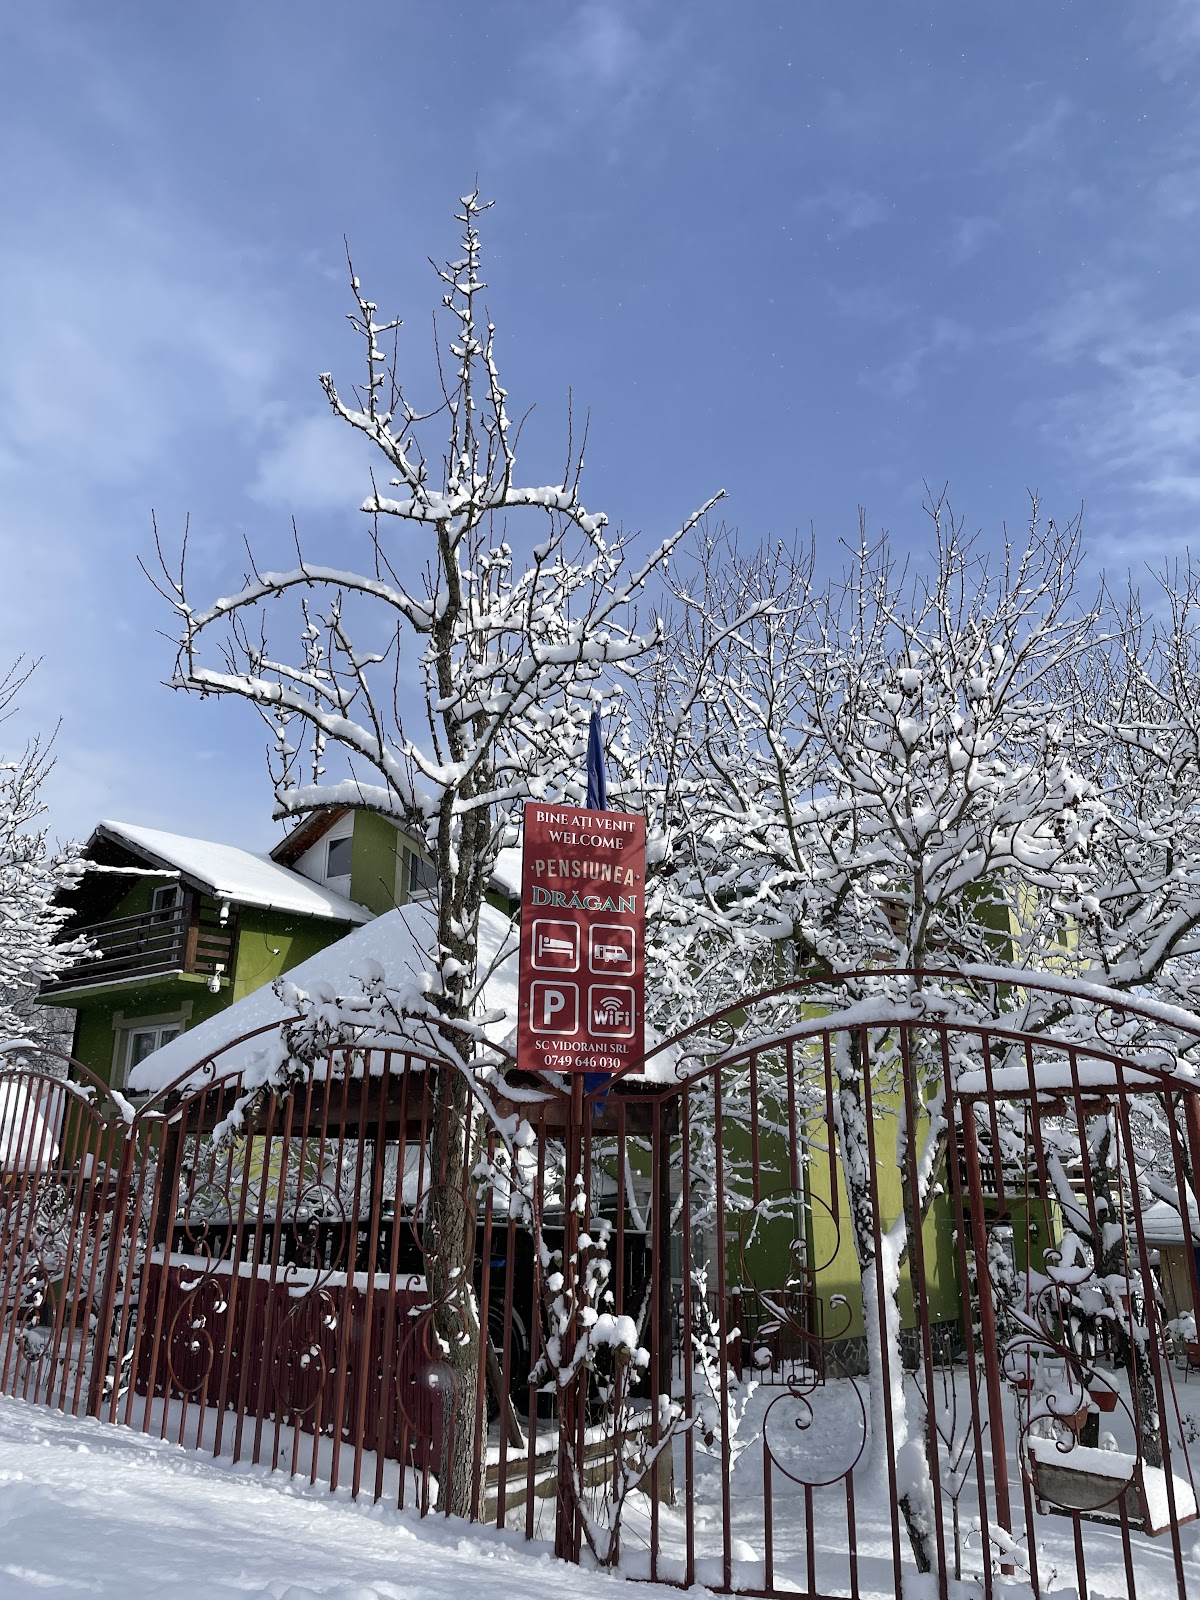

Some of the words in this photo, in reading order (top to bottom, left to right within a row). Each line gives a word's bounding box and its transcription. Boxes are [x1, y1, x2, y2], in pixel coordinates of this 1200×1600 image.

[537, 811, 568, 825] BINE
[595, 819, 635, 832] VENIT
[549, 831, 624, 849] WELCOME
[535, 859, 634, 887] PENSIUNEA
[531, 885, 637, 914] DRĂGAN
[544, 990, 565, 1024] P
[535, 1040, 549, 1050] SC
[552, 1041, 607, 1052] VIDORANI
[610, 1044, 629, 1053] SRL
[544, 1055, 572, 1066] 0749
[575, 1056, 596, 1067] 646
[600, 1057, 620, 1068] 030
